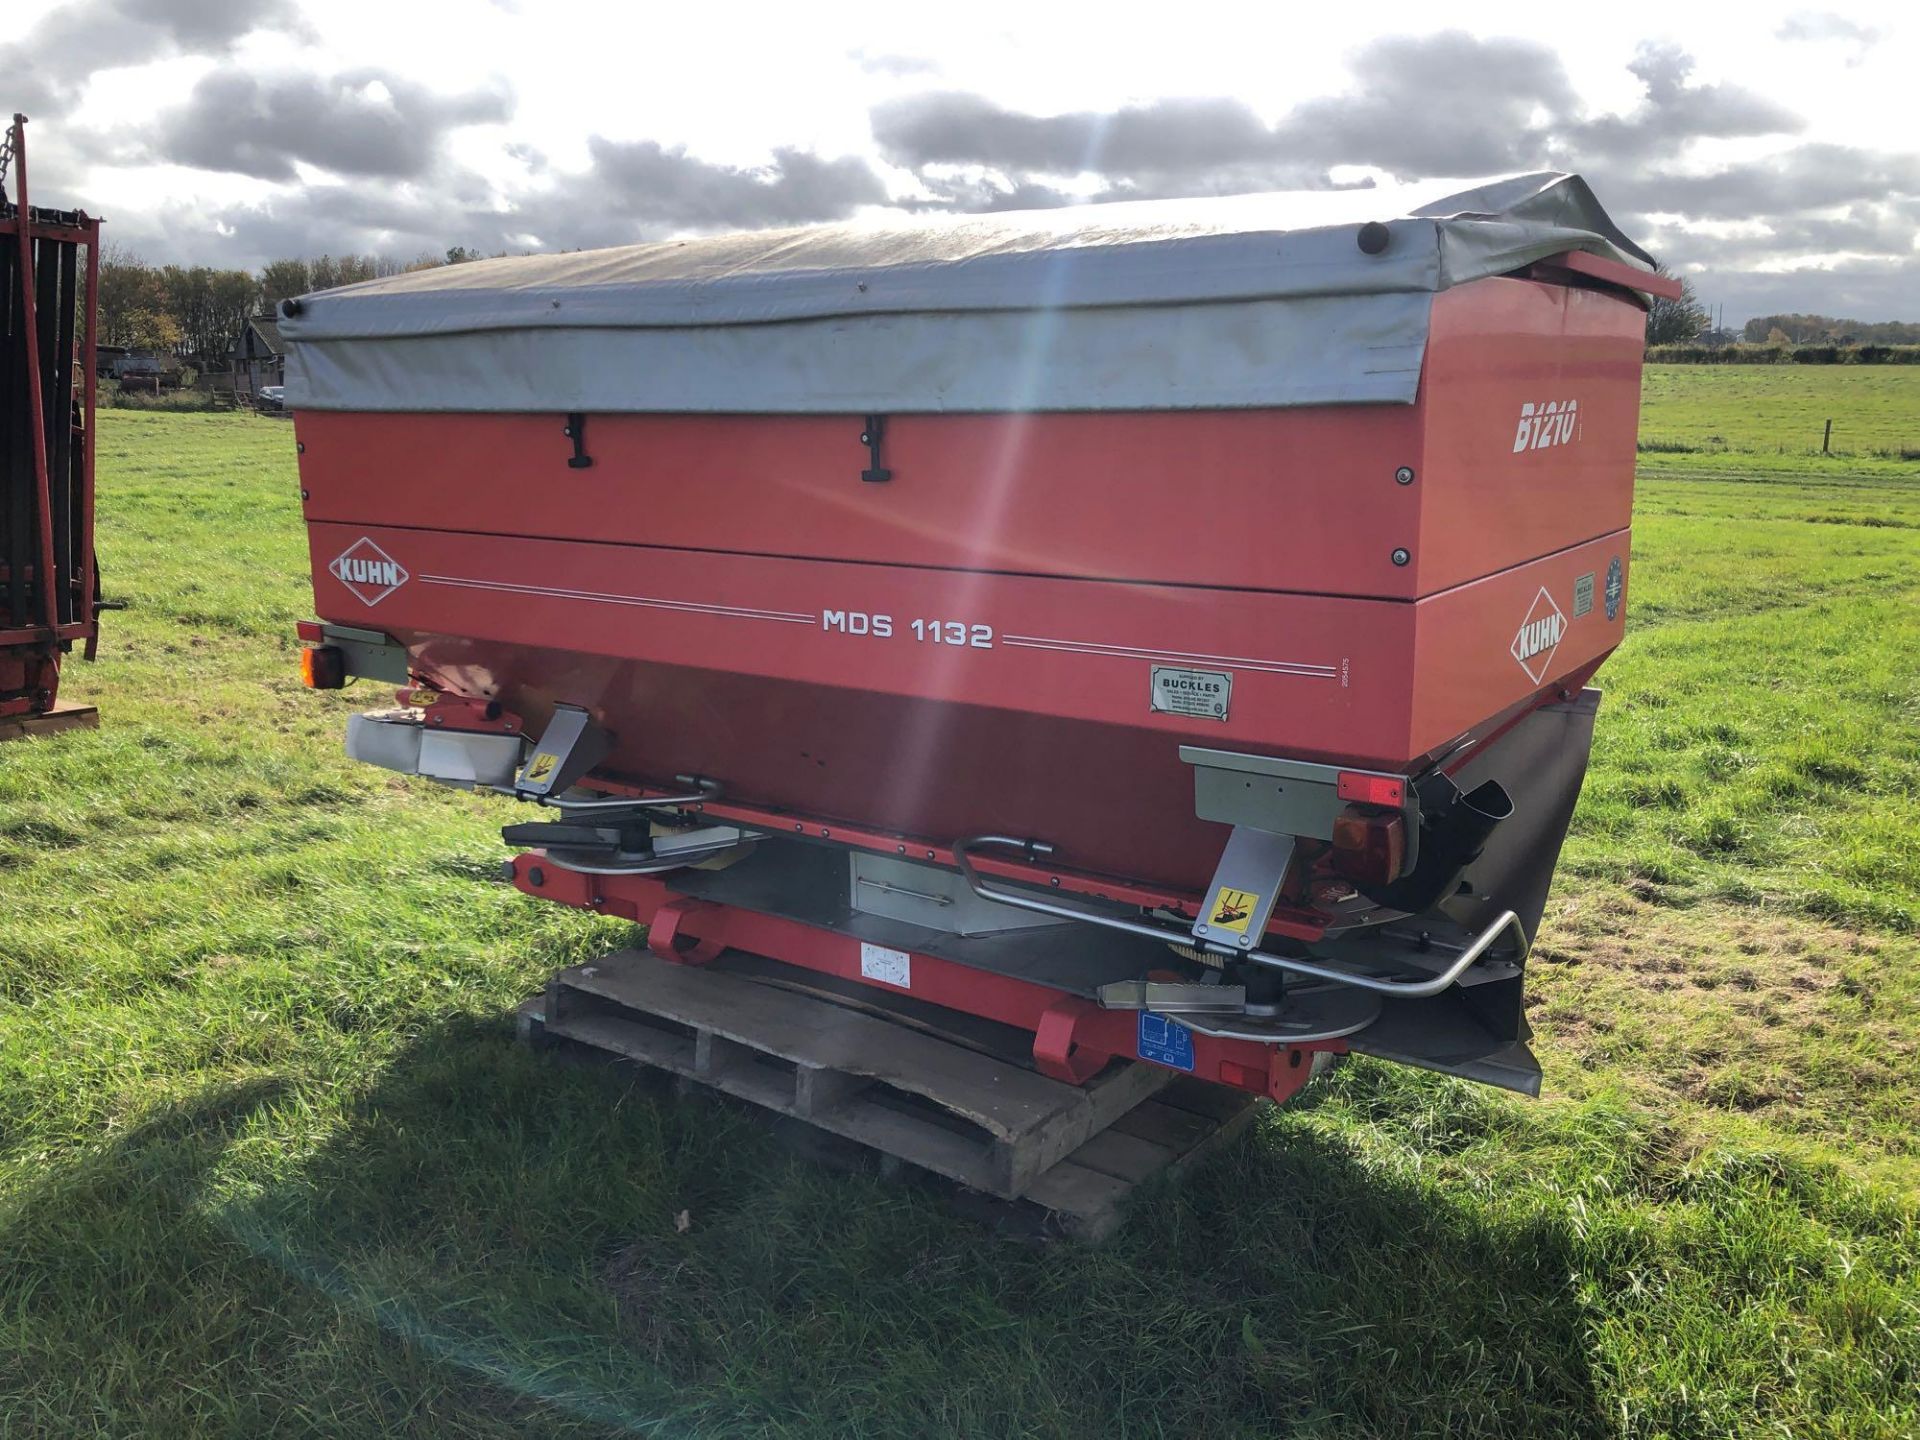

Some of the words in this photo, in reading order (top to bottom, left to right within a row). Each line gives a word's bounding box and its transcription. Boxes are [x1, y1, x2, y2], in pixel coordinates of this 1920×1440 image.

[1513, 399, 1577, 453] B1210
[340, 558, 398, 586] KUHN
[823, 609, 893, 638] MDS
[911, 618, 993, 649] 1132
[1519, 612, 1561, 661] KUHN
[1163, 678, 1220, 693] BUCKLES
